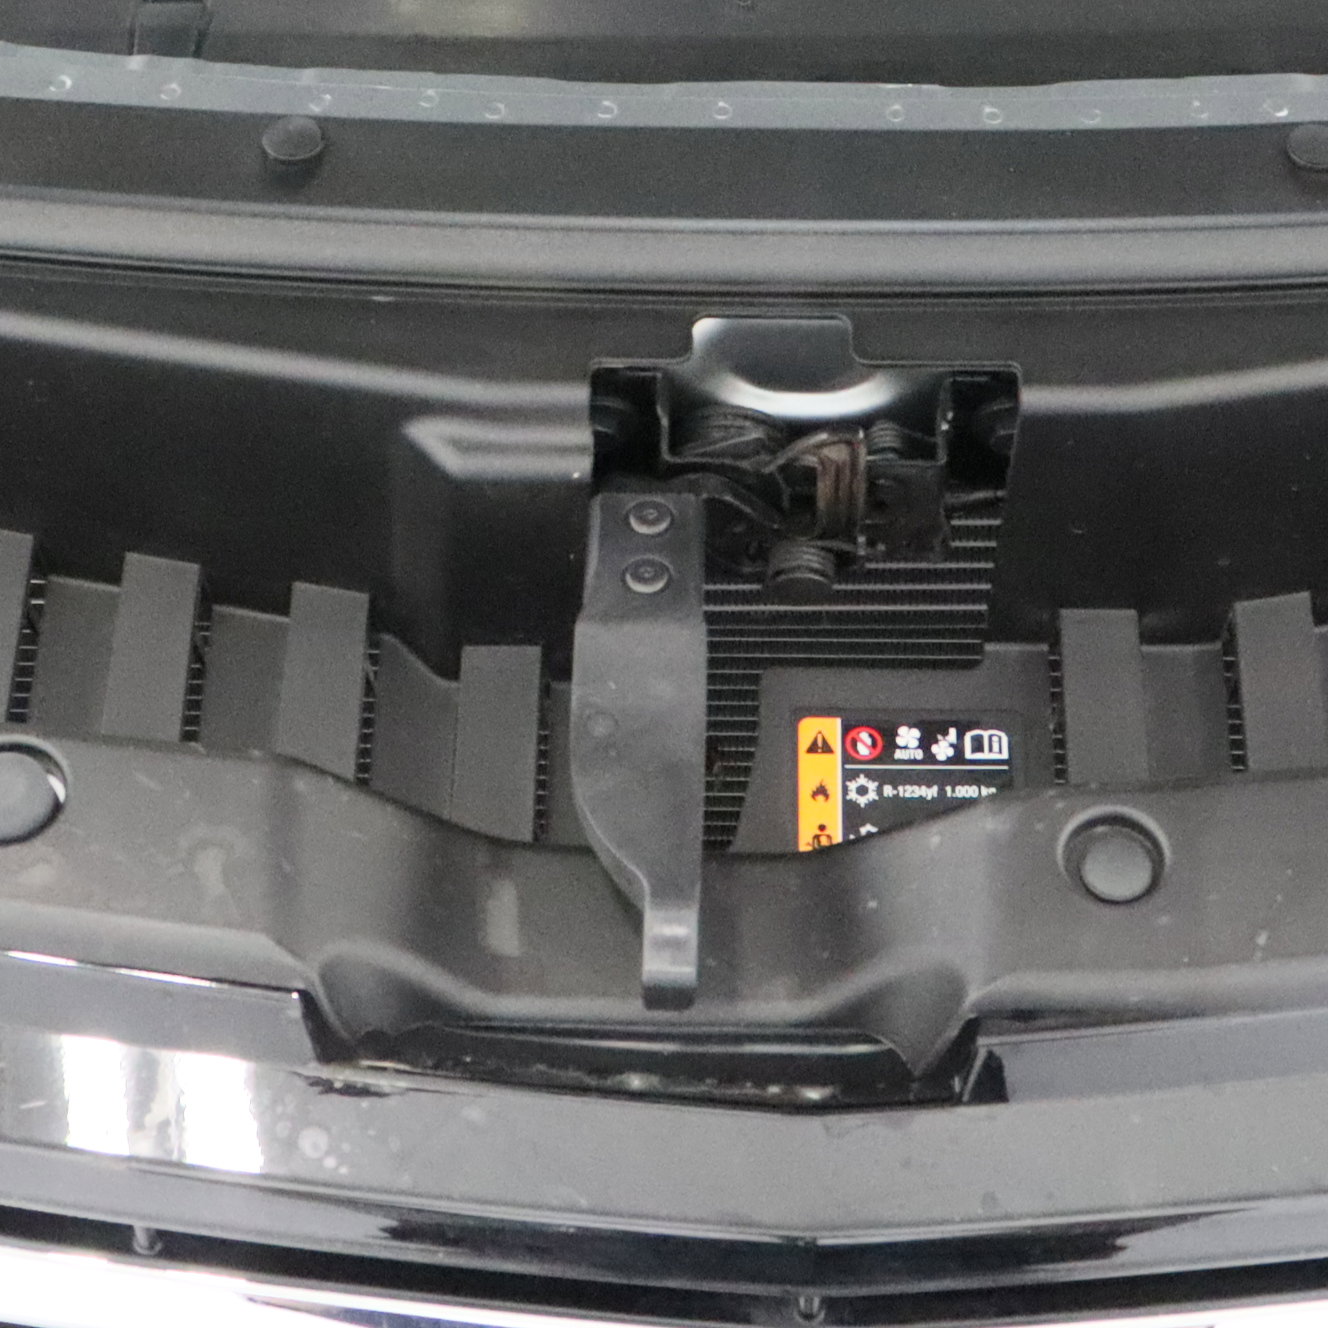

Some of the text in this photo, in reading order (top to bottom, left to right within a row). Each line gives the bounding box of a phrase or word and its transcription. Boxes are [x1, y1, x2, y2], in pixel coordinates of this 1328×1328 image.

[893, 748, 924, 760] AUTO
[882, 784, 938, 800] R-1234yf
[945, 785, 979, 798] 1.000
